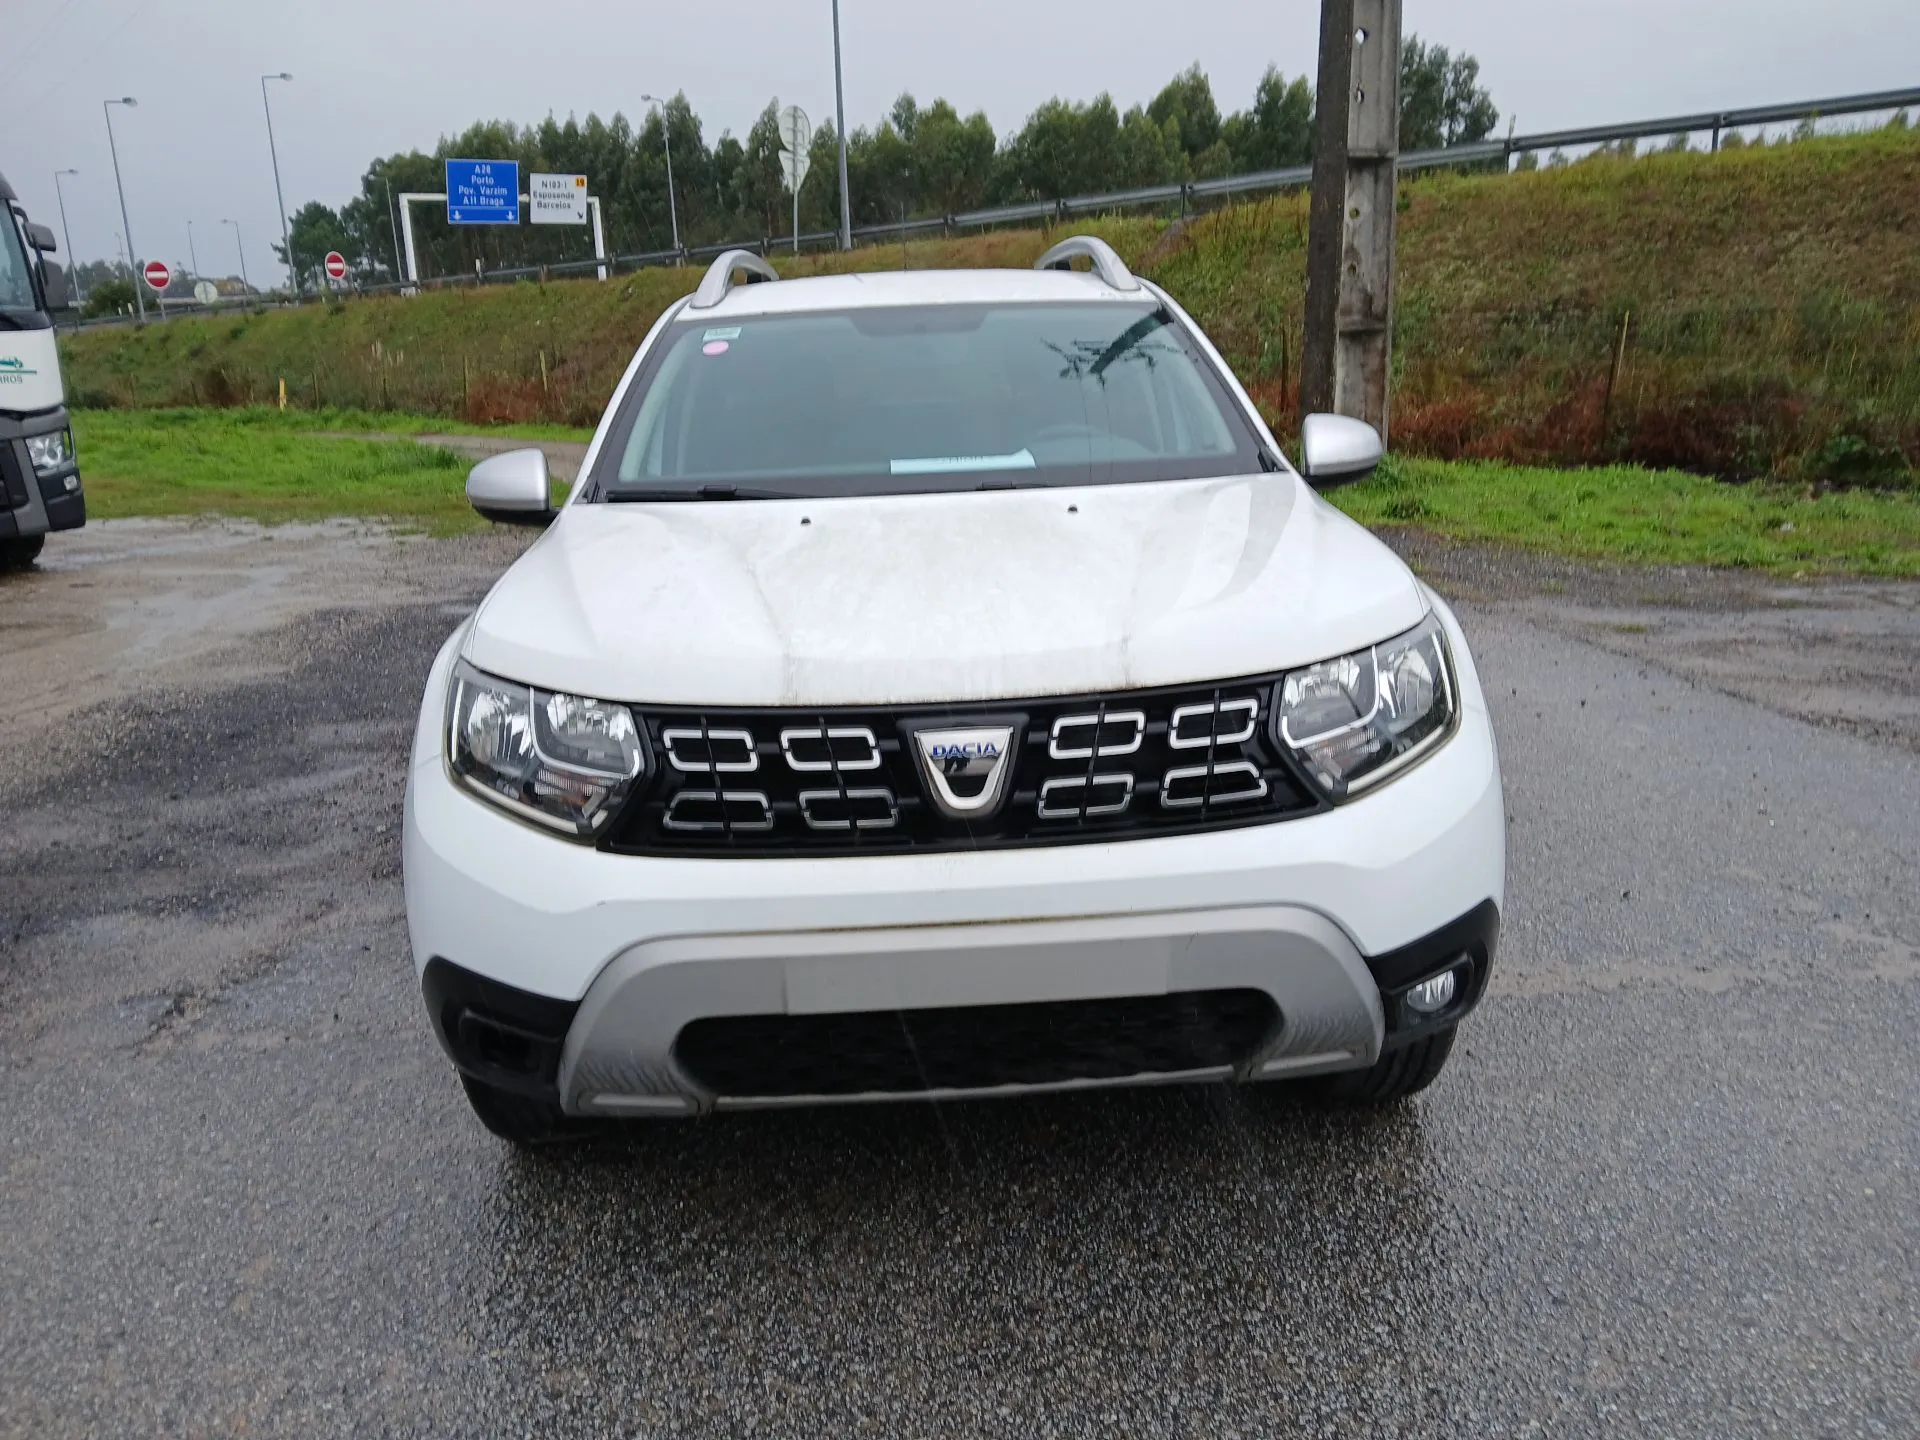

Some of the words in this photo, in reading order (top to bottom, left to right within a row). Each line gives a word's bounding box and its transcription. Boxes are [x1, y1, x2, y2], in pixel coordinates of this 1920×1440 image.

[471, 175, 495, 185] Porto
[480, 185, 508, 196] Varzim
[532, 190, 575, 200] Esposende
[480, 196, 505, 207] Braga
[536, 201, 571, 209] Barcelos
[932, 742, 998, 759] DACIA
